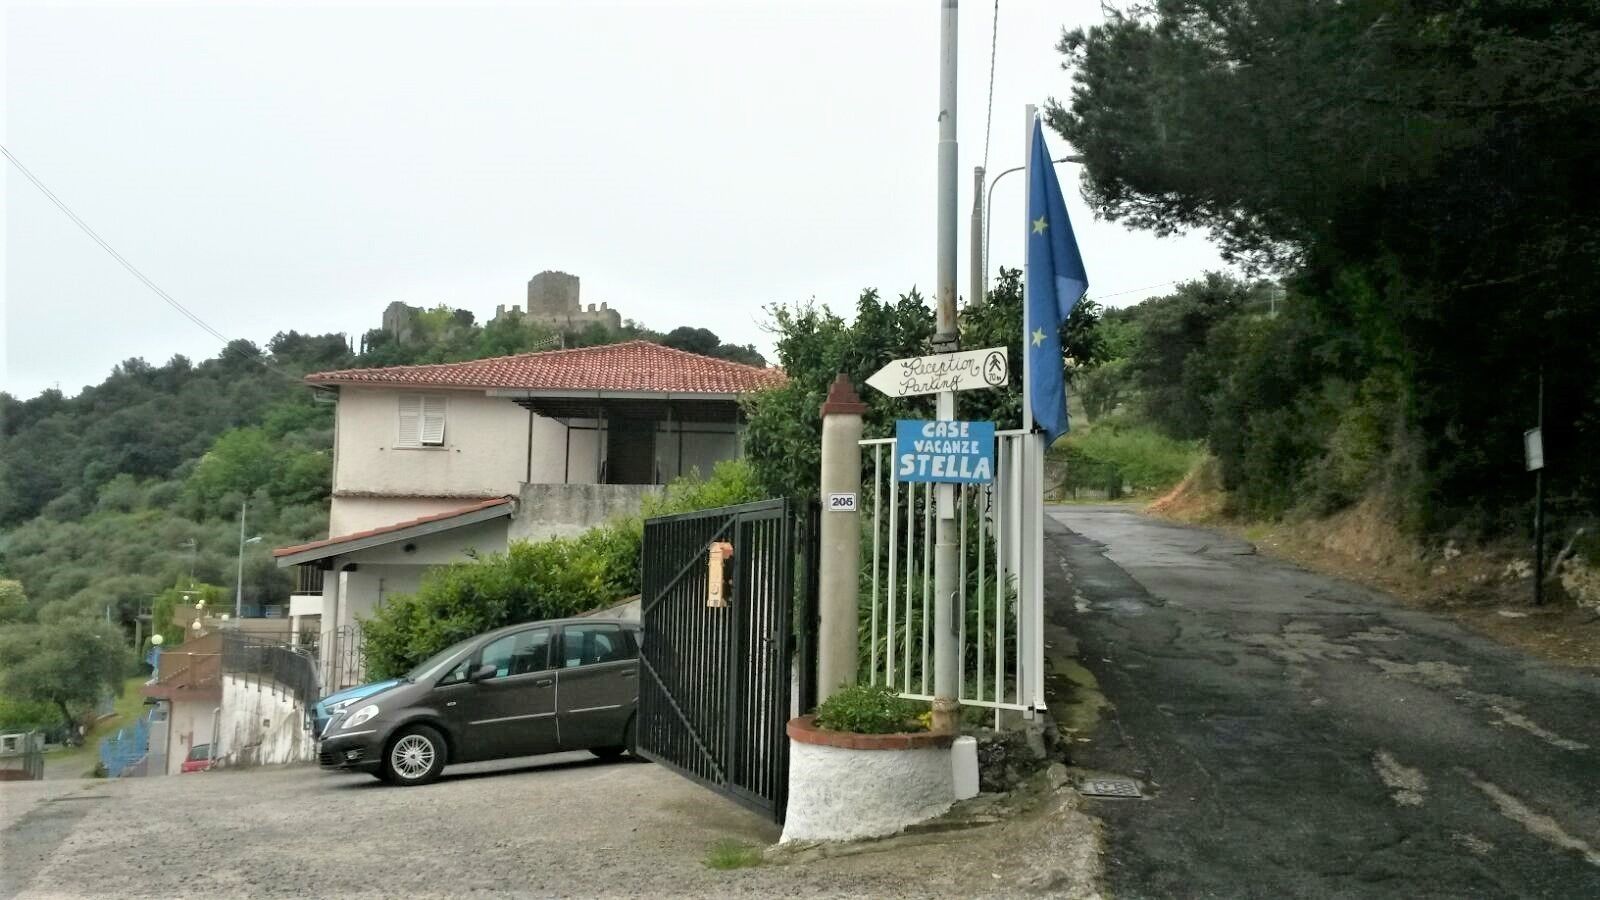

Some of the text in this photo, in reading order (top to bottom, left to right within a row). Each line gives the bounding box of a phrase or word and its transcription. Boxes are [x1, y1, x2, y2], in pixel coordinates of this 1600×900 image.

[901, 355, 979, 377] Reception
[899, 375, 963, 395] Parking
[922, 422, 969, 438] CASE
[914, 441, 979, 454] VACANZE
[900, 454, 991, 479] STELLA
[832, 497, 853, 506] 205
